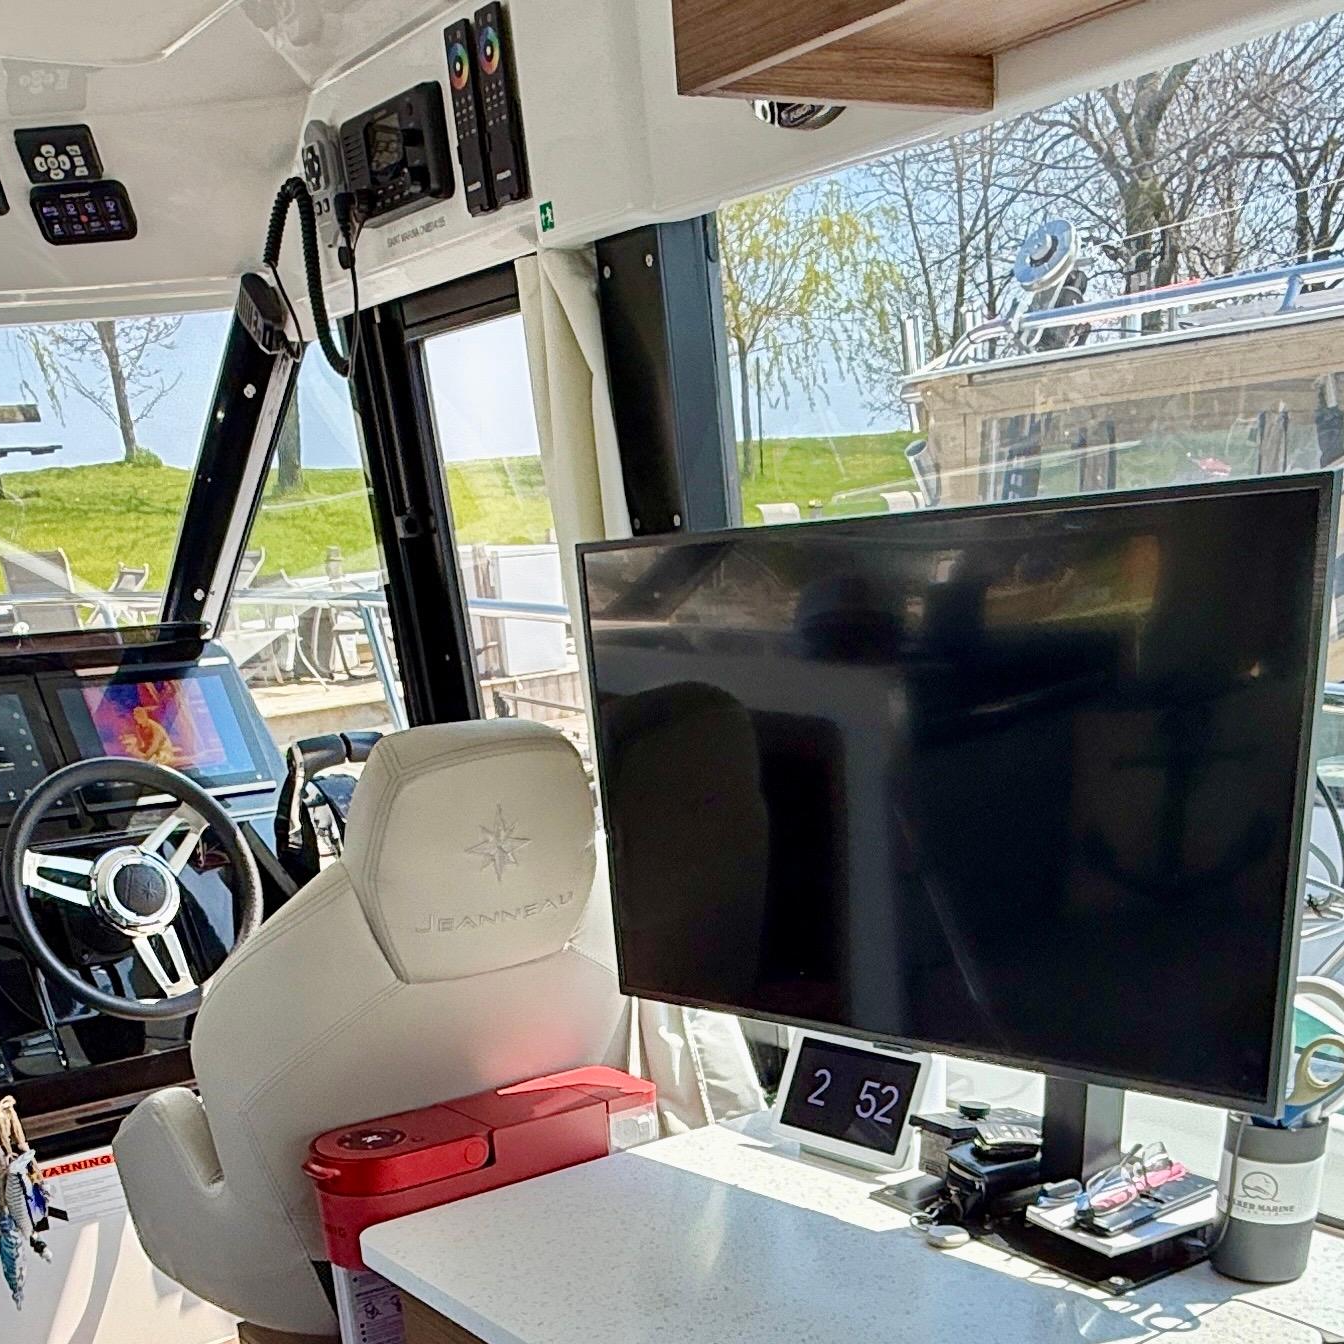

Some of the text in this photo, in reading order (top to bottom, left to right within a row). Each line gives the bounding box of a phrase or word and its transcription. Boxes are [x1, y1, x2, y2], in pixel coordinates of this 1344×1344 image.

[415, 891, 574, 934] JEANNEAU
[807, 1068, 900, 1125] 2 52
[1257, 1205, 1295, 1213] MARINE
